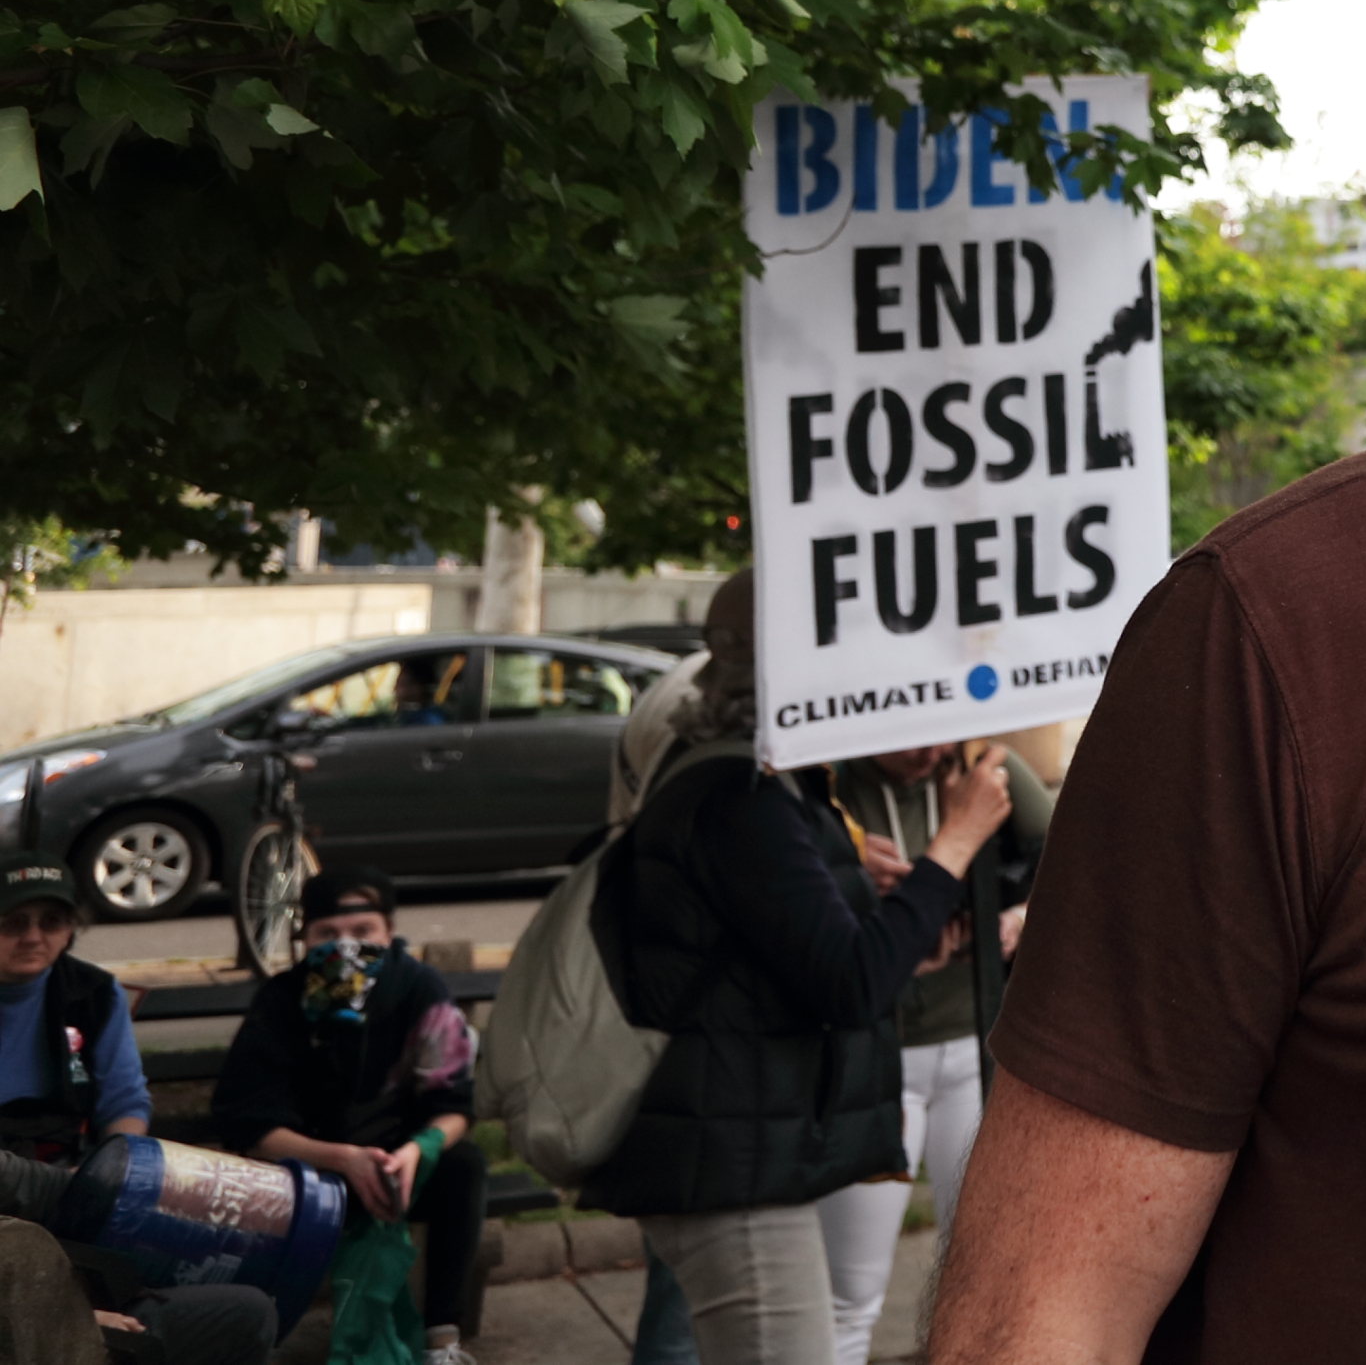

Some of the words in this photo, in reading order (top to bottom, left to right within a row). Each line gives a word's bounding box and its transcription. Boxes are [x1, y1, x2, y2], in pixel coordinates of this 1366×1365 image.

[852, 238, 1055, 354] END
[788, 373, 1135, 504] FOSSIL
[812, 504, 1115, 646] FUELS
[775, 680, 953, 729] CLIMATE
